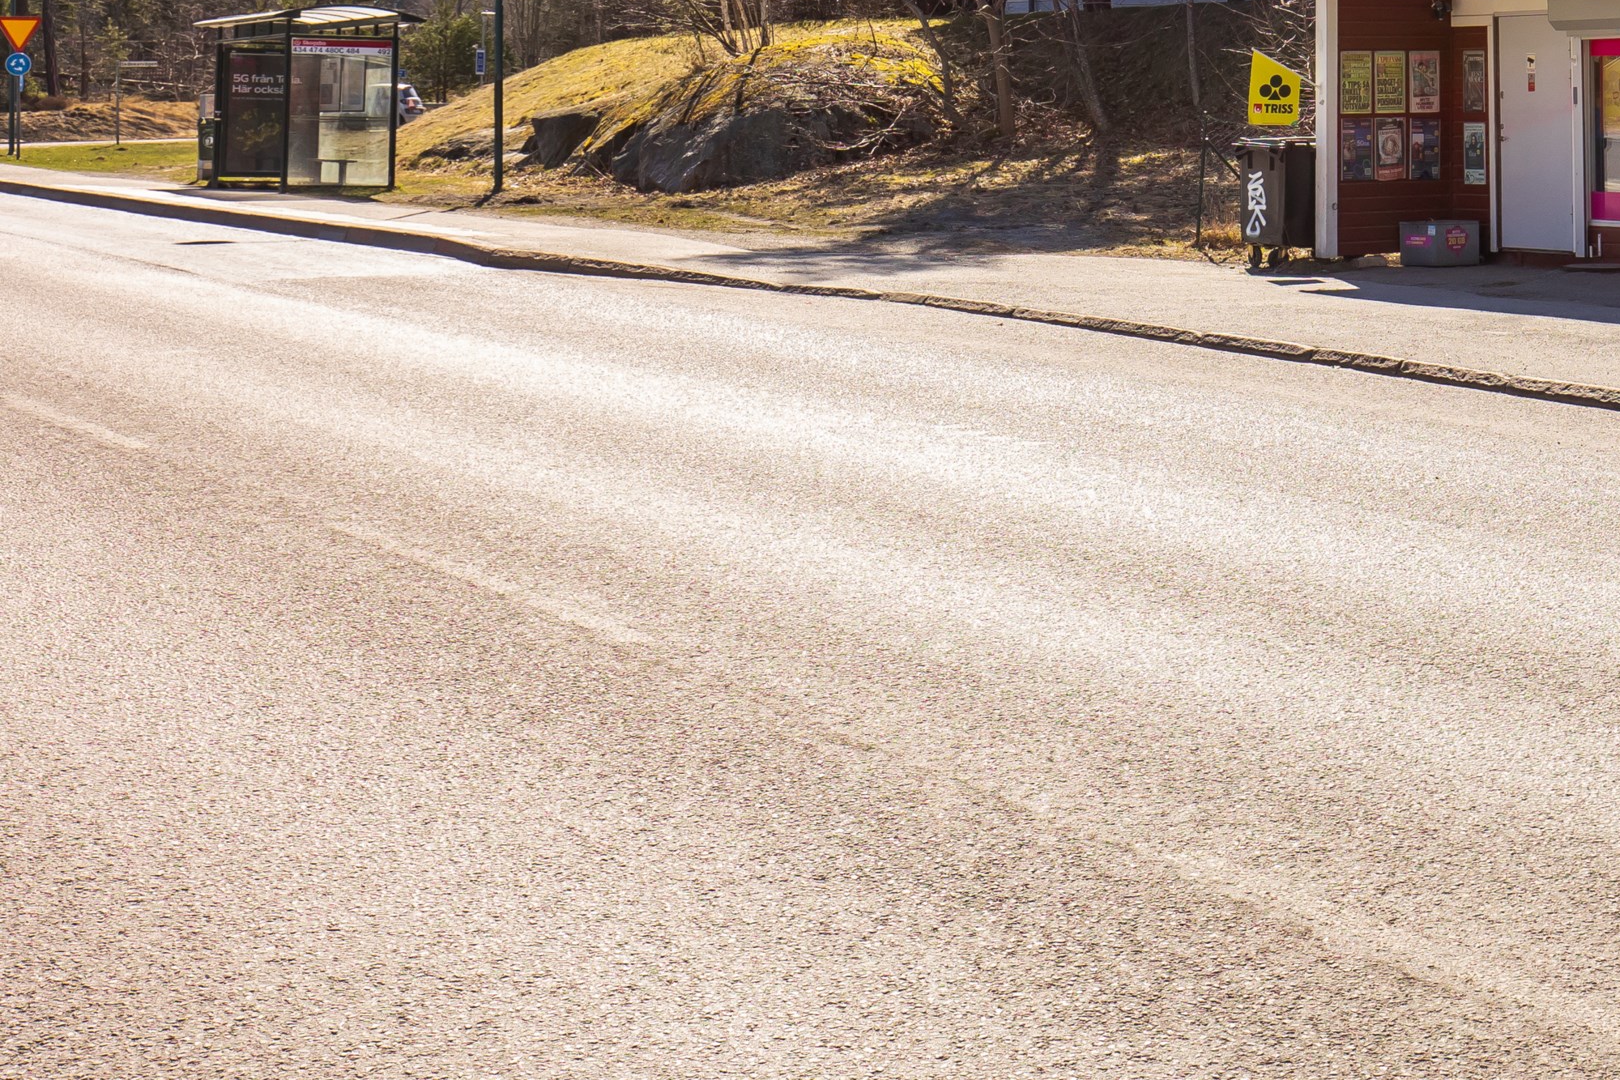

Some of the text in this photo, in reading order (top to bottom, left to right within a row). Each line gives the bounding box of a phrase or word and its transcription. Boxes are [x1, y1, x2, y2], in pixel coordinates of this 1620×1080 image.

[233, 73, 302, 85] 5G från Tia.
[232, 84, 251, 93] Här
[1264, 103, 1293, 114] TRISS
